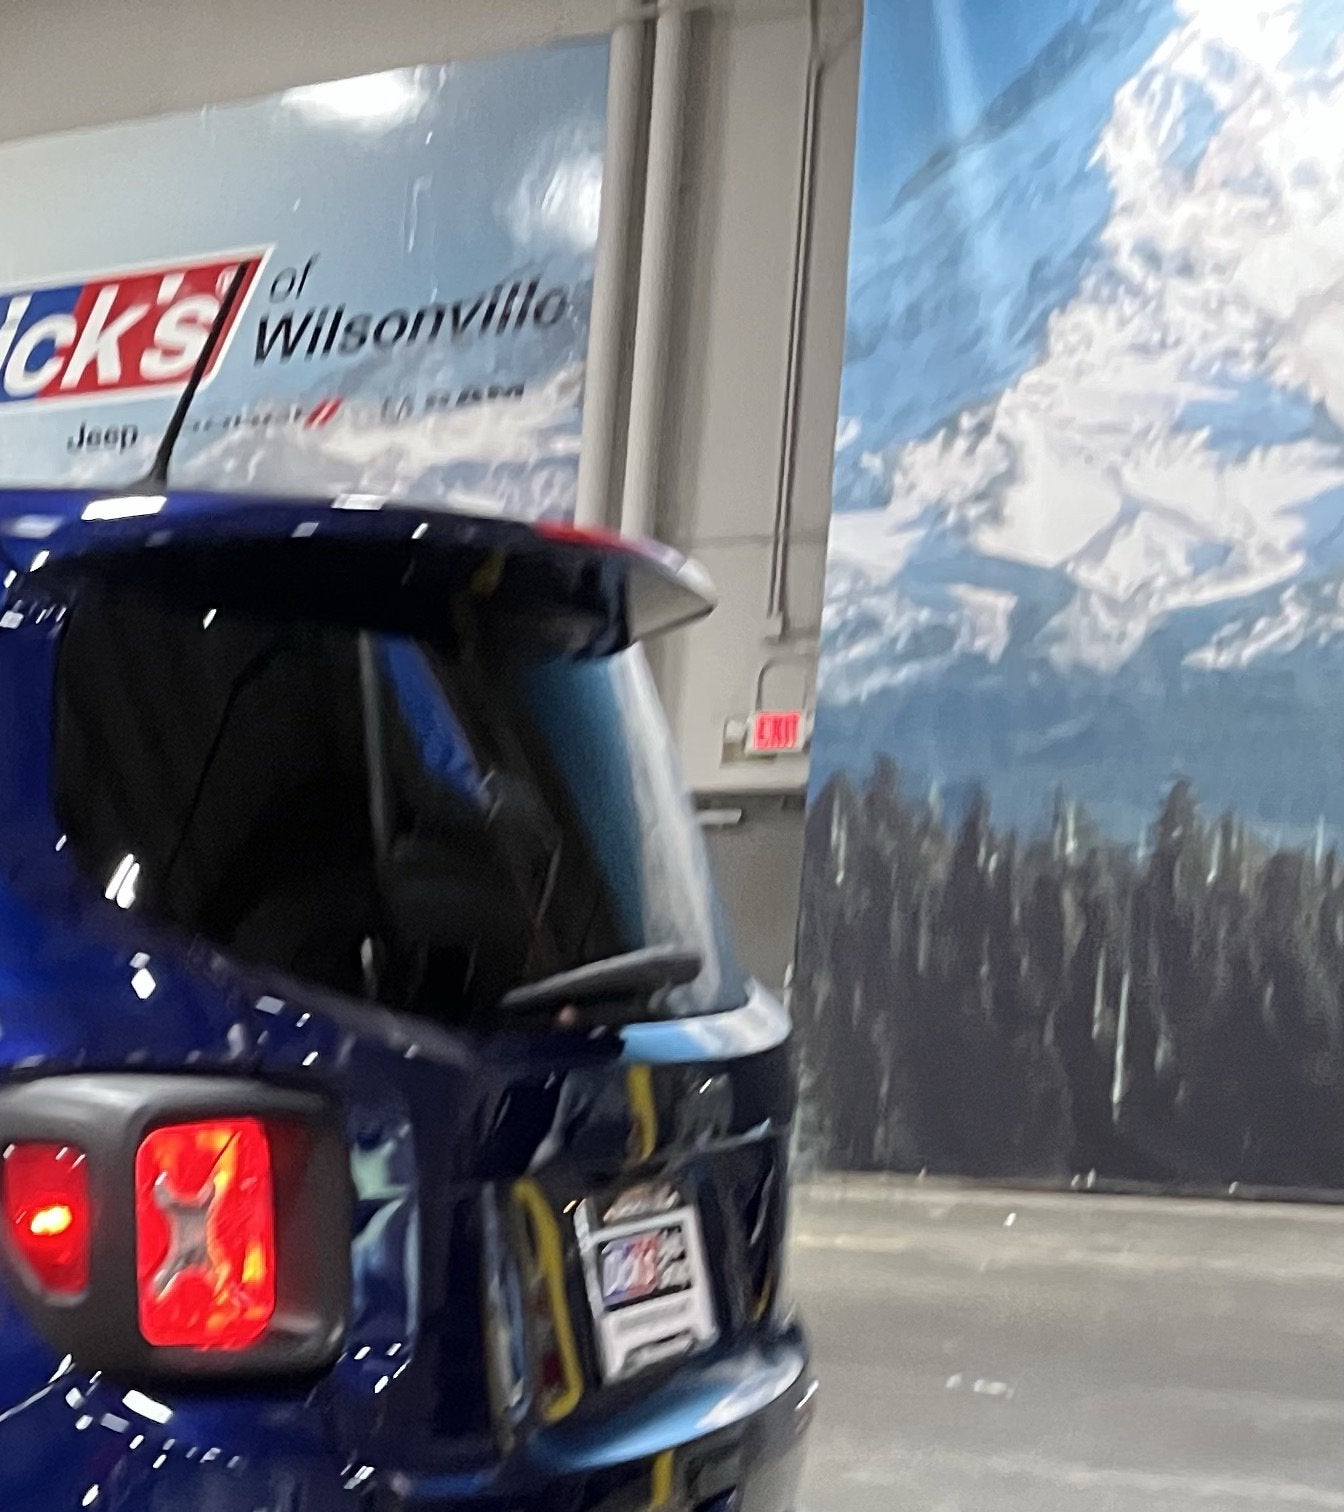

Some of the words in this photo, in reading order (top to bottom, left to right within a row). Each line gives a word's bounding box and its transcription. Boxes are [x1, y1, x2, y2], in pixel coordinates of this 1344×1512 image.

[269, 252, 319, 302] of
[254, 272, 569, 368] Wilsonville
[66, 421, 140, 452] Jeep
